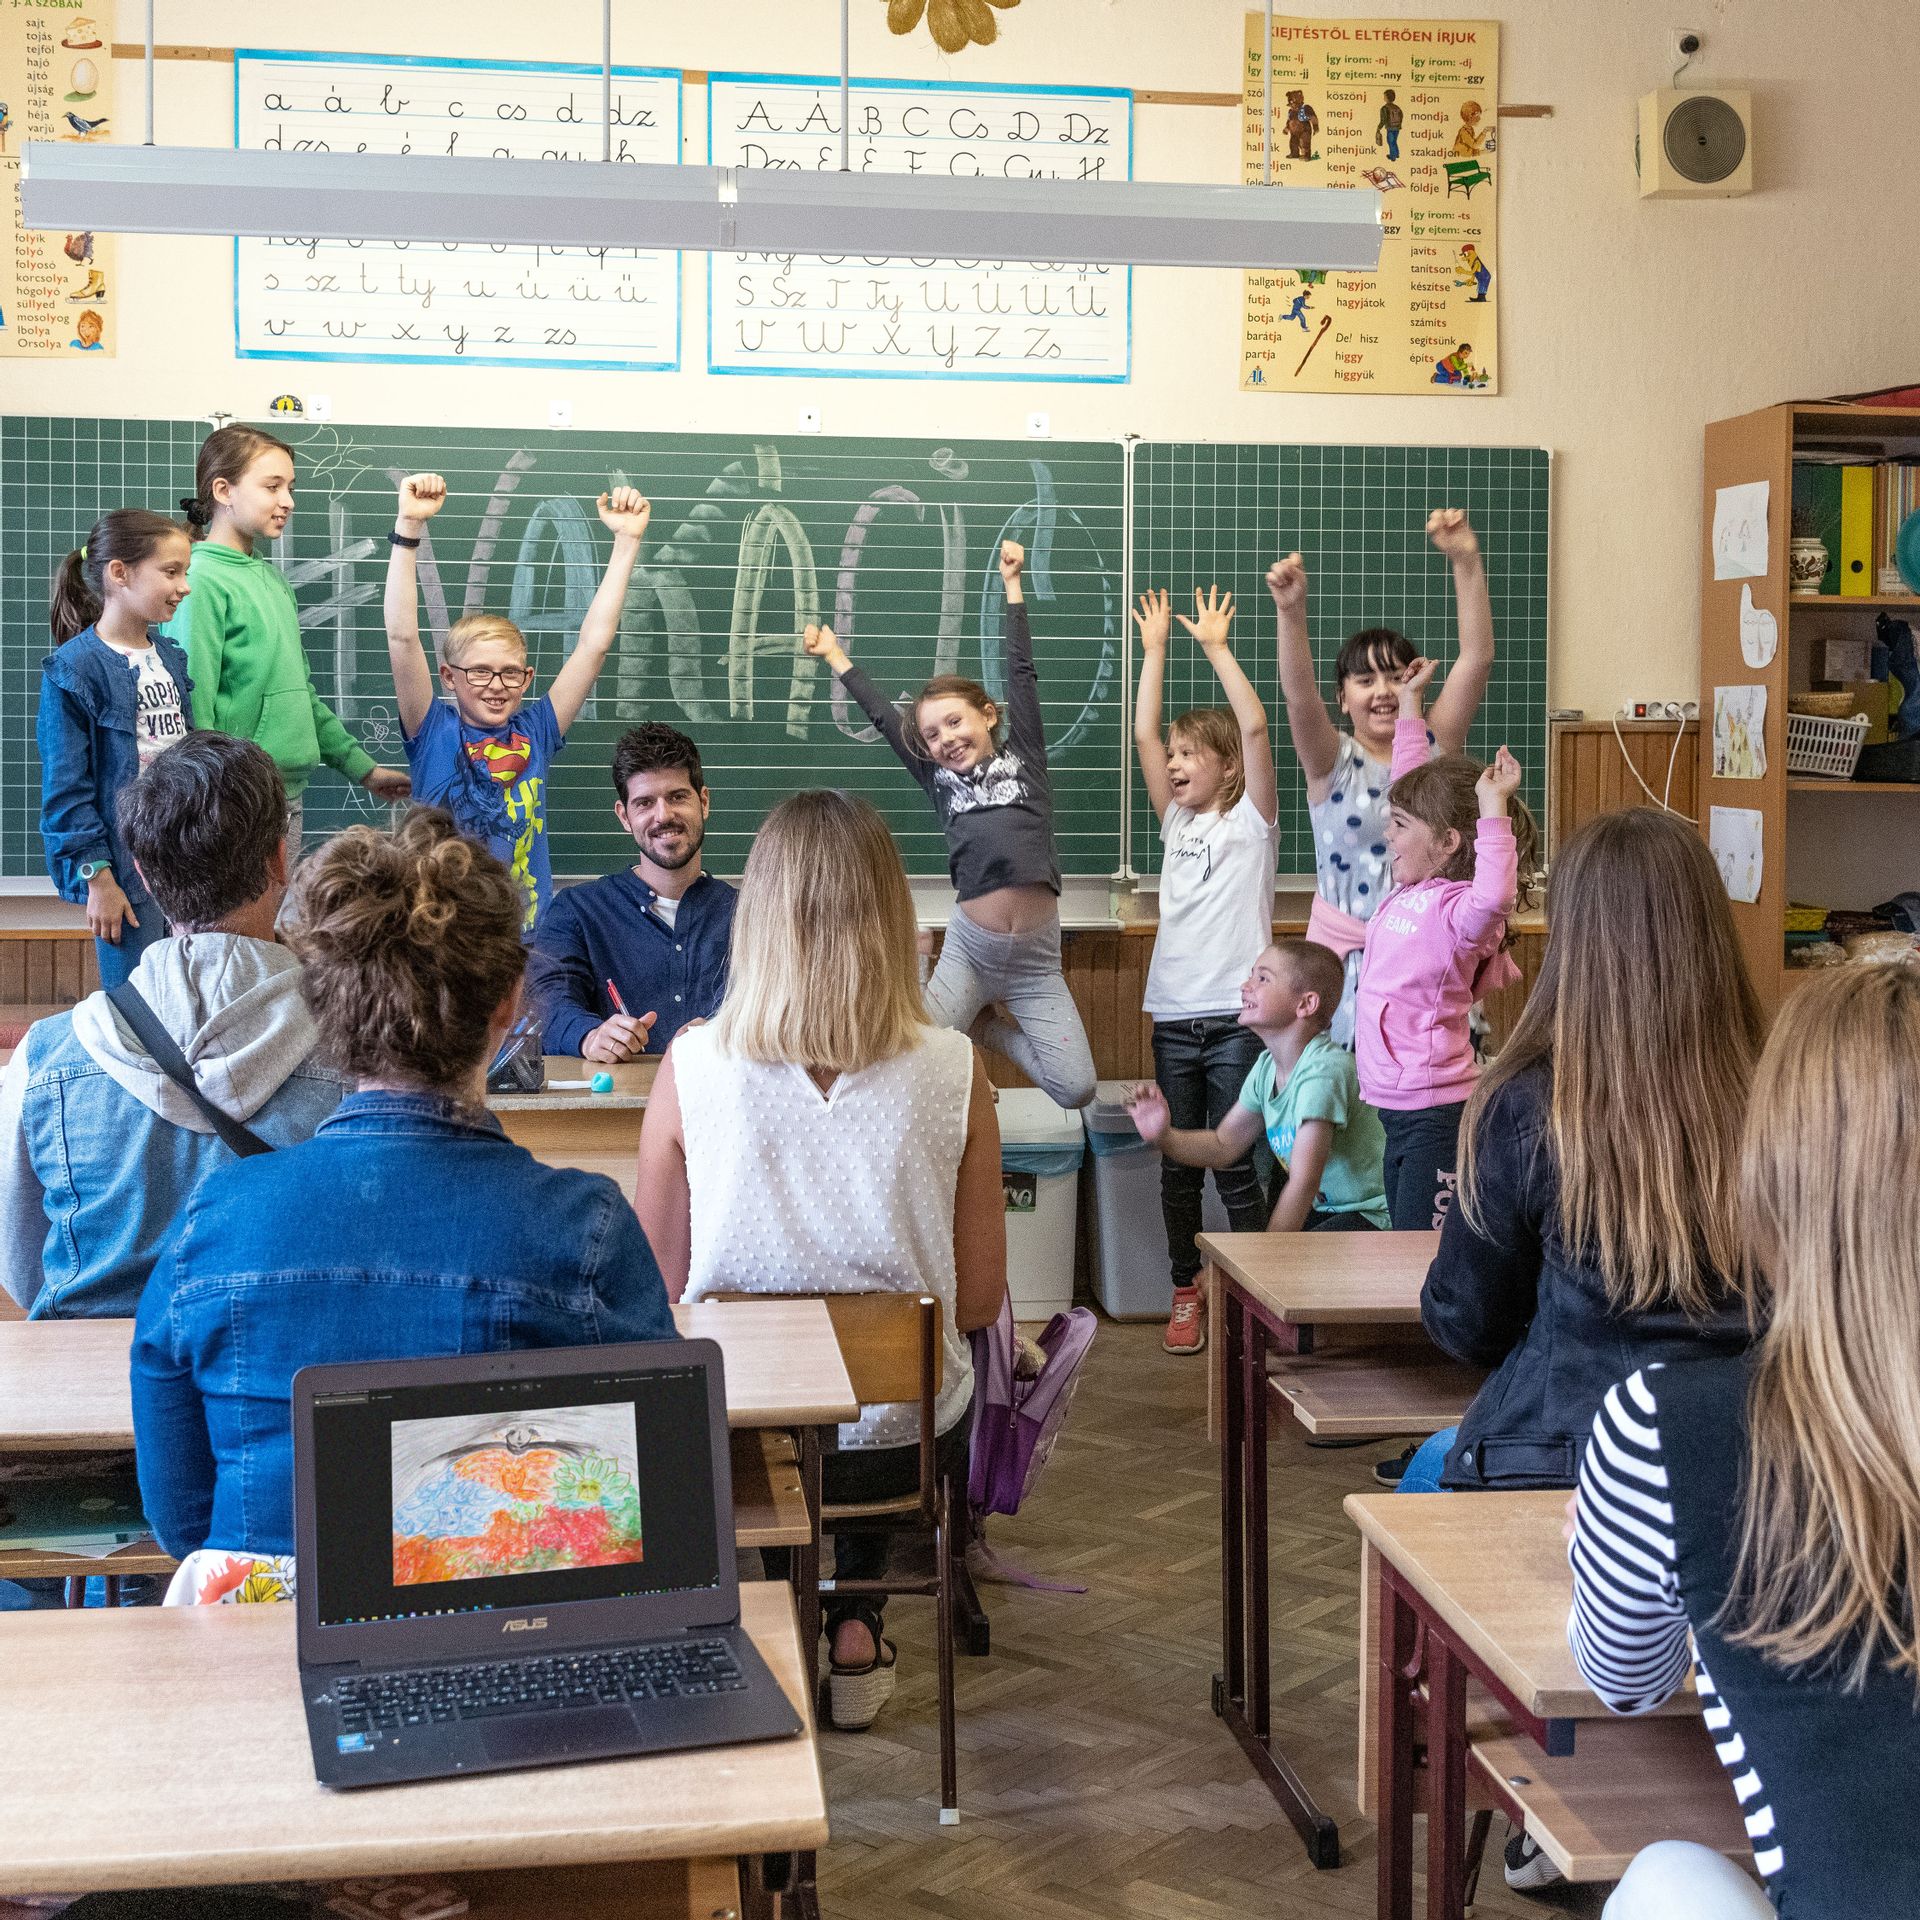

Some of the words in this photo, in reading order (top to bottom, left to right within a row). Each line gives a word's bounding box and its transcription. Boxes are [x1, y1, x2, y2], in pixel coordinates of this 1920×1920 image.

[26, 20, 45, 29] sajt
[27, 32, 52, 42] tojás
[1355, 28, 1431, 42] ELTÉRŐEN
[1438, 30, 1476, 45] ÍRJUK
[27, 45, 54, 55] tejföl
[1249, 48, 1261, 61] Így
[27, 57, 49, 68] hajó
[1327, 52, 1341, 65] Így
[1345, 55, 1371, 63] írom:
[1376, 56, 1387, 66] -nj
[1411, 57, 1425, 67] Így
[1459, 59, 1471, 69] -dj
[27, 71, 47, 81] ajtó
[1248, 65, 1261, 77] Így
[1327, 67, 1341, 80] Így
[1345, 70, 1376, 80] ejtem:
[1381, 73, 1401, 81] -nny
[1411, 70, 1425, 82] Így
[1429, 73, 1460, 83] ejtem:
[1464, 76, 1484, 84] -ggy
[28, 84, 54, 96] újság
[28, 98, 47, 108] rajz
[1327, 91, 1366, 103] köszönj
[1411, 93, 1439, 105] adjon
[264, 93, 292, 110] a
[324, 85, 352, 113] á
[380, 84, 410, 115] b
[448, 101, 464, 118] c
[497, 103, 527, 120] cs
[556, 93, 584, 123] d
[28, 110, 49, 121] héja
[736, 101, 783, 131] A
[796, 91, 842, 133] Á
[858, 106, 882, 135] B
[902, 107, 930, 137] C
[949, 108, 989, 139] Cs
[1007, 111, 1040, 141] D
[1058, 113, 1110, 144] Dz
[1327, 109, 1352, 120] menj
[1411, 112, 1449, 123] mondja
[28, 124, 54, 134] varjú
[1327, 126, 1362, 138] bánjon
[1411, 129, 1443, 141] tudjuk
[1327, 144, 1376, 156] pihenjünk
[1410, 147, 1460, 159] szakadjon
[1327, 162, 1355, 174] kenje
[1411, 165, 1437, 176] padja
[1410, 183, 1439, 195] földje
[1411, 208, 1424, 220] Így
[1411, 225, 1425, 235] Így
[1429, 227, 1459, 235] ejtem:
[15, 234, 45, 245] folyik
[16, 247, 43, 257] folyó
[1411, 247, 1436, 257] javíts
[16, 260, 56, 271] folyosó
[1411, 264, 1451, 273] tanítson
[17, 273, 68, 285] korcsolya
[264, 273, 279, 290] s
[305, 273, 340, 292] sz
[360, 262, 378, 294] t
[399, 264, 436, 308] ty
[463, 278, 497, 298] u
[516, 270, 549, 300] ú
[568, 276, 601, 301] ü
[614, 274, 648, 303] ű
[1249, 276, 1295, 289] hallgatjuk
[1337, 279, 1376, 291] hagyjon
[17, 286, 60, 298] hógolyó
[1411, 282, 1450, 292] készítse
[736, 275, 755, 306] S
[771, 276, 807, 307] Sz
[827, 279, 851, 308] T
[866, 280, 904, 323] Ty
[920, 281, 960, 312] U
[972, 272, 1011, 314] Ú
[1020, 276, 1060, 315] Ü
[1066, 274, 1106, 316] Ű
[1248, 294, 1270, 306] futja
[1337, 297, 1385, 309] hagyjátok
[17, 300, 55, 310] süllyed
[1410, 300, 1445, 311] gyűjtsd
[17, 313, 69, 325] mosolyog
[1248, 313, 1274, 325] botja
[1411, 318, 1446, 327] számíts
[18, 326, 50, 337] Ibolya
[264, 319, 295, 336] v
[323, 321, 367, 338] w
[391, 323, 420, 340] x
[443, 323, 469, 354] y
[494, 326, 514, 343] z
[544, 328, 577, 346] zs
[1247, 331, 1281, 343] barátja
[736, 320, 776, 351] V
[798, 321, 858, 353] W
[872, 324, 911, 355] X
[928, 325, 959, 368] Y
[975, 326, 1001, 356] Z
[1024, 328, 1062, 358] Zs
[1336, 333, 1352, 342] De!
[1360, 334, 1378, 343] hisz
[1411, 336, 1456, 347] segítsünk
[18, 339, 61, 350] Orsolya
[1246, 350, 1275, 361] partja
[1336, 351, 1363, 363] higgy
[1410, 353, 1434, 364] építs
[1335, 370, 1374, 381] higgyük
[502, 1616, 548, 1632] ASUS
